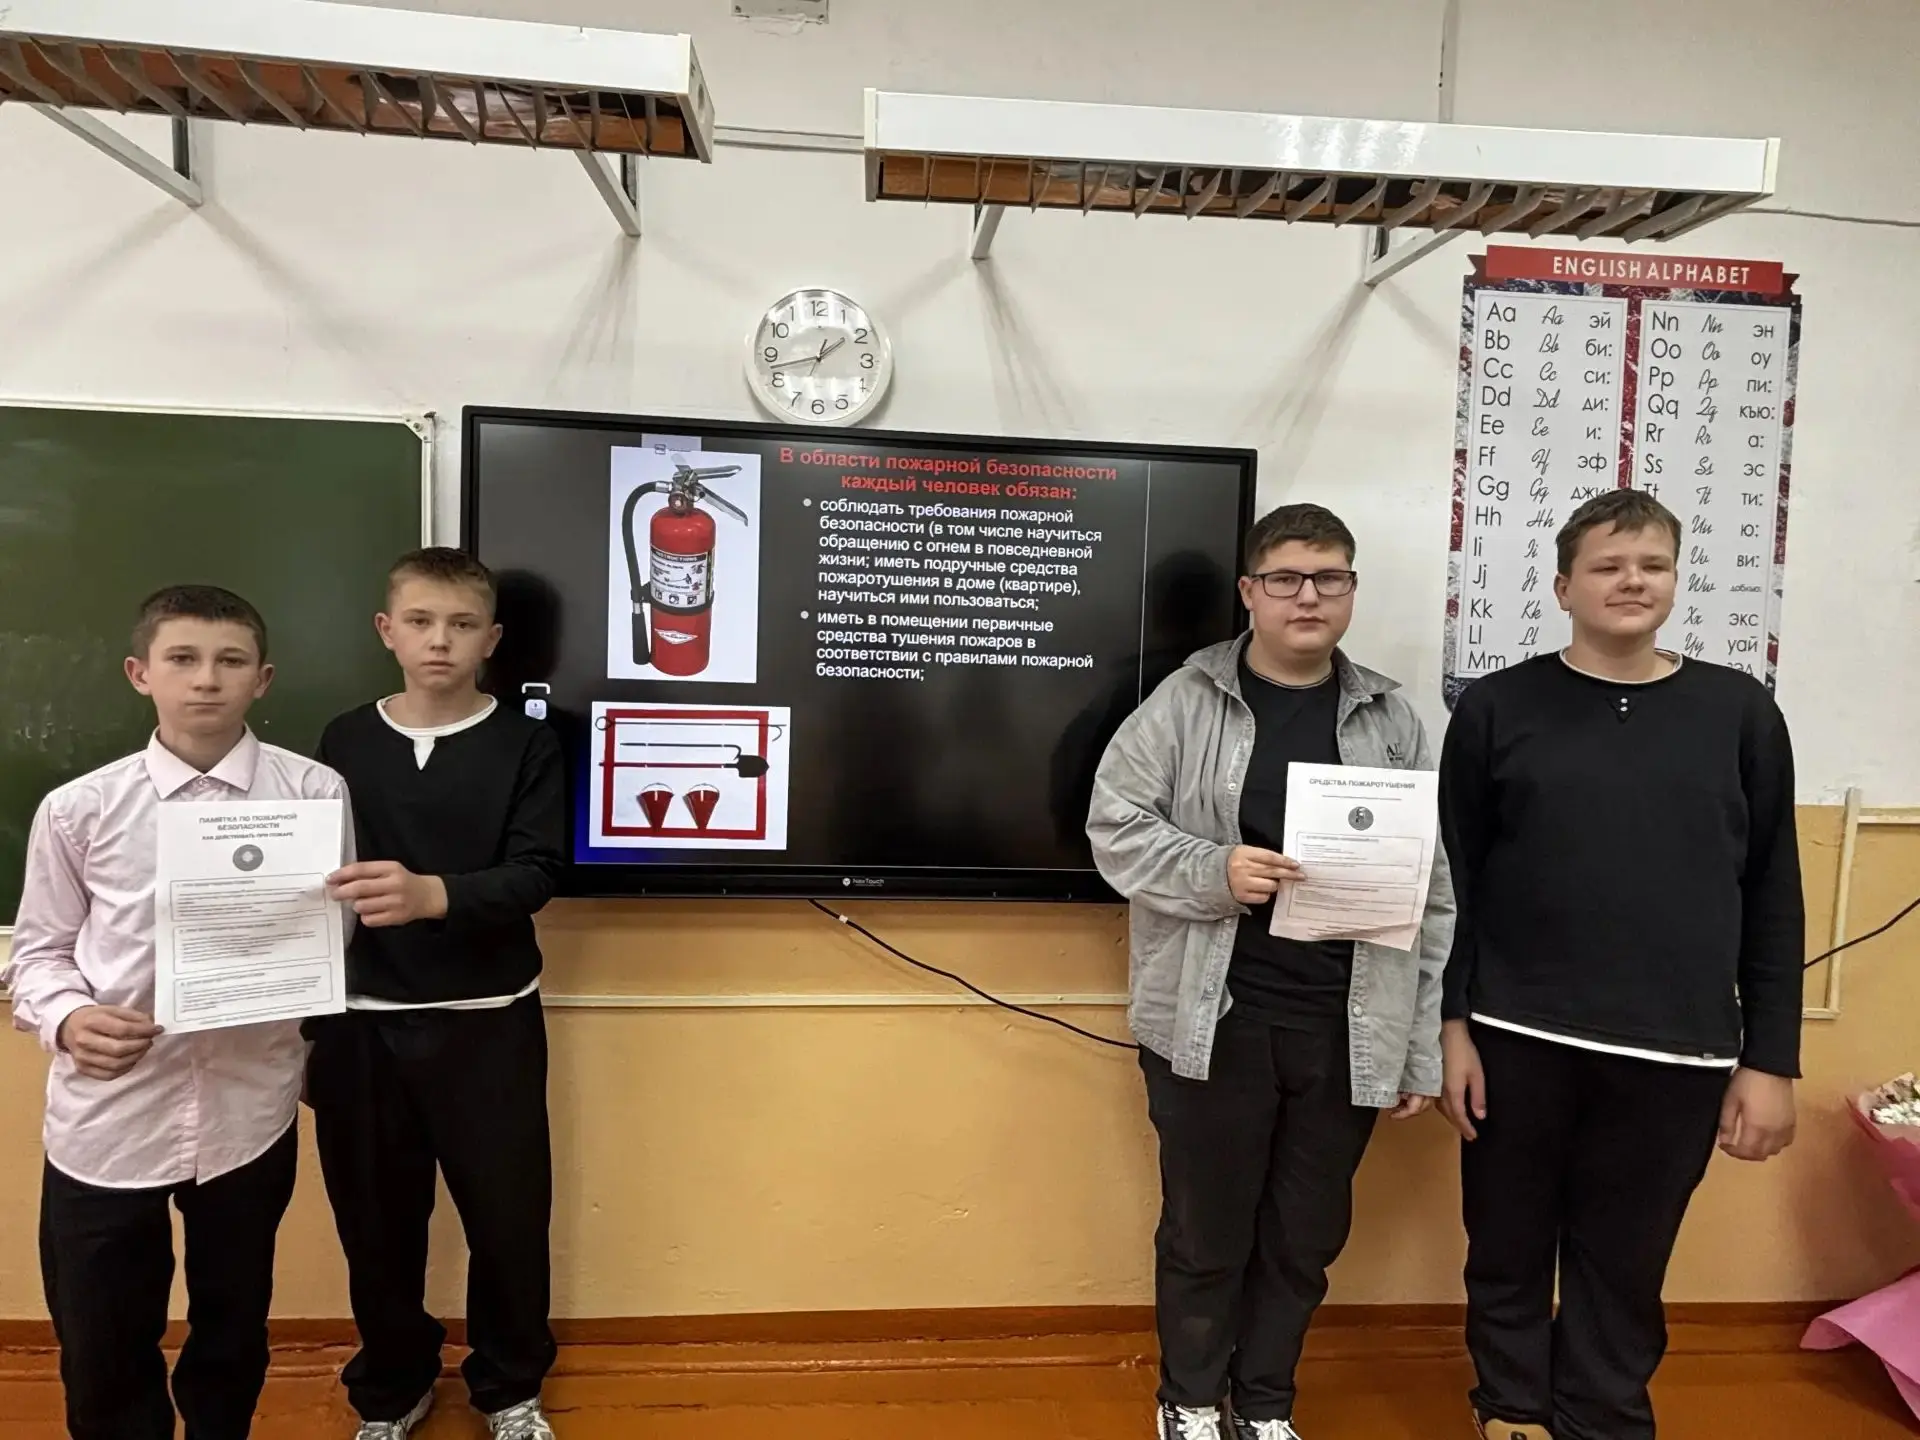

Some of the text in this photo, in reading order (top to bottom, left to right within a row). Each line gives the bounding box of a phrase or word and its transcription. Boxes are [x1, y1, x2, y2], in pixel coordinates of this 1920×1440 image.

[1552, 255, 1750, 286] ENGLISH ALPHABET
[811, 300, 829, 317] 12
[1487, 302, 1516, 322] Aa
[1590, 312, 1610, 328] эй
[770, 322, 789, 339] 10
[1652, 311, 1678, 331] Nn
[1753, 325, 1774, 338] эн
[854, 328, 868, 344] 2
[1485, 330, 1510, 350] Bb
[1586, 339, 1612, 356] би:
[764, 346, 778, 363] 9
[860, 353, 874, 369] 3
[1651, 338, 1681, 359] Oo
[1751, 352, 1771, 368] оу
[771, 372, 785, 388] 8
[1484, 358, 1513, 378] Cc
[1584, 371, 1610, 384] си:
[1649, 366, 1674, 391] Pp
[1747, 380, 1772, 393] пи:
[791, 391, 802, 407] 7
[1482, 386, 1511, 406] Dd
[811, 399, 825, 415] 6
[1648, 394, 1678, 419] Qq
[1481, 414, 1504, 435] Ee
[1587, 427, 1601, 440] и:
[1646, 423, 1664, 442] Rr
[779, 447, 1117, 481] В области пожарной безопасности
[1479, 446, 1496, 466] Ff
[1578, 453, 1607, 473] эф
[1645, 453, 1662, 473] Ss
[1744, 464, 1764, 477] эс
[841, 475, 1077, 499] каждый человек обязан:
[1478, 475, 1509, 501] Gg
[1742, 493, 1763, 506] ти:
[820, 498, 1073, 524] соблюдать требования пожарной
[1476, 506, 1501, 526] Hh
[819, 516, 1102, 543] безопасности (в том числе научиться
[1741, 524, 1759, 537] ю:
[819, 534, 1093, 559] обращению с огнем в повседневной
[818, 554, 1078, 576] жизни; иметь подручные средства
[1737, 555, 1759, 567] ви:
[819, 572, 1081, 595] пожаротушения в доме (квартире),
[818, 590, 1039, 610] научиться ими пользоваться;
[1471, 599, 1492, 618] Kk
[818, 612, 1054, 632] иметь в помещении первичные
[1729, 613, 1758, 626] экс
[817, 630, 1036, 650] средства тушения пожаров в
[1728, 637, 1758, 654] уай
[816, 648, 1094, 670] соответствии с правилами пожарной
[1467, 651, 1506, 670] Mm
[816, 663, 925, 681] безопасности;
